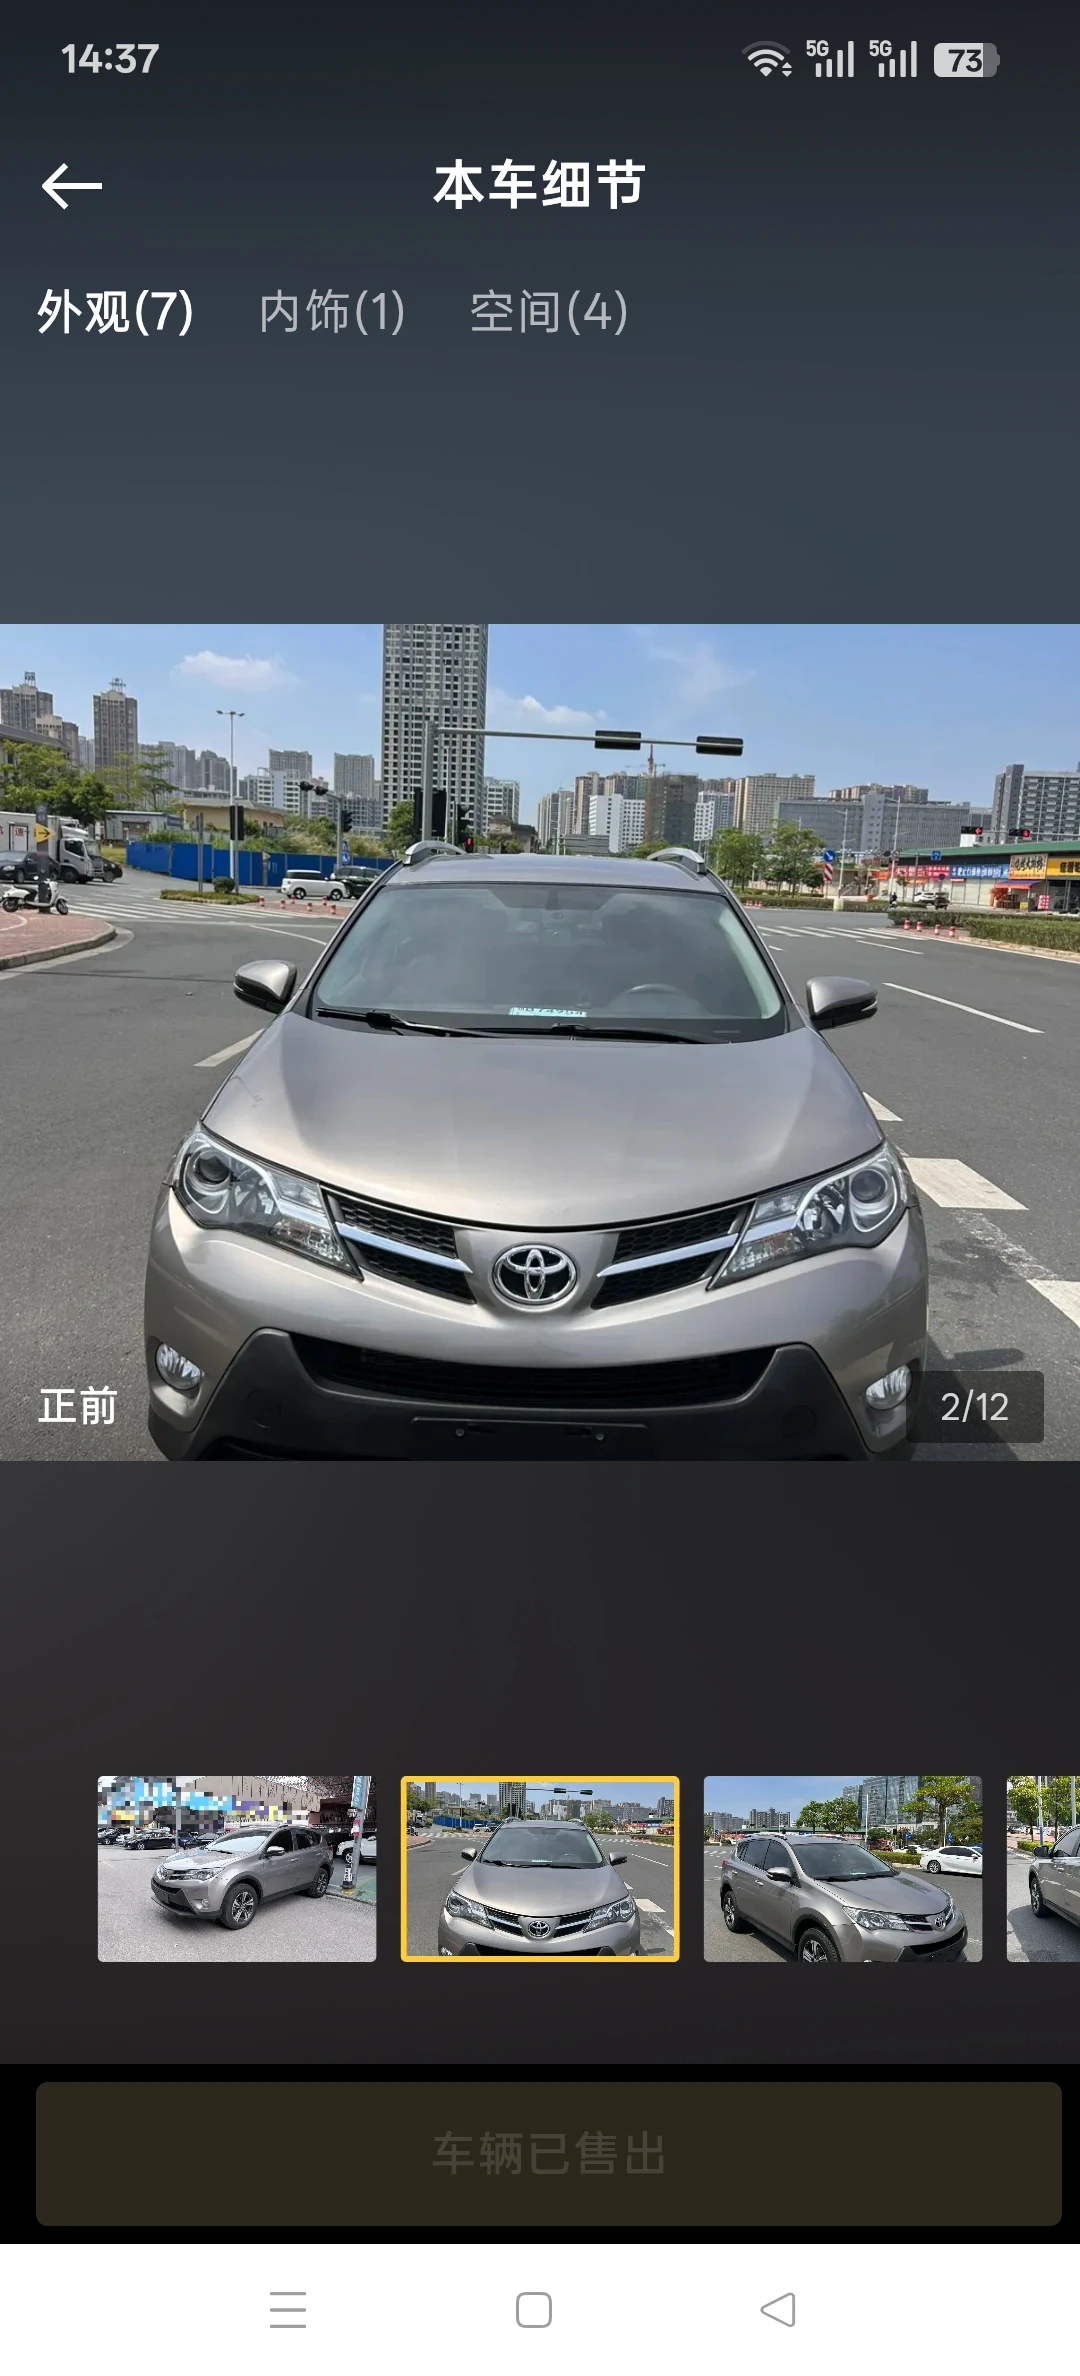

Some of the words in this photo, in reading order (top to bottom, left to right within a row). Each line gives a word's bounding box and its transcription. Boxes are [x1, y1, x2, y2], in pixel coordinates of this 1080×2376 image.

[62, 44, 159, 73] 14:37
[806, 39, 829, 57] 5G
[869, 39, 892, 57] 5G
[948, 49, 982, 72] 73
[433, 158, 646, 210] 本车细节
[37, 289, 194, 337] 外观(7)
[260, 289, 405, 336] 内饰(1)
[470, 289, 628, 336] 空间(4)
[432, 2130, 665, 2175] 车辆已售出
